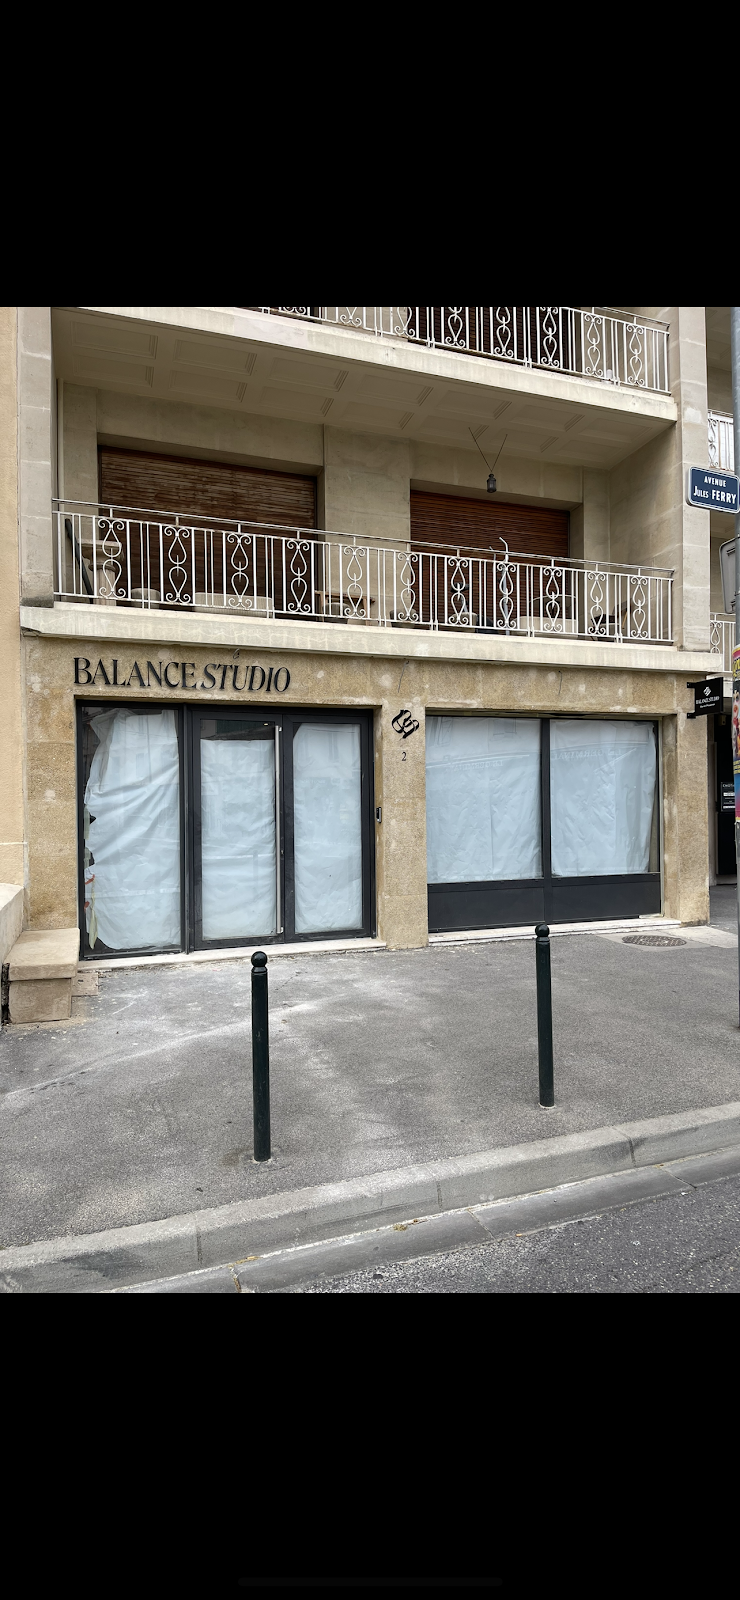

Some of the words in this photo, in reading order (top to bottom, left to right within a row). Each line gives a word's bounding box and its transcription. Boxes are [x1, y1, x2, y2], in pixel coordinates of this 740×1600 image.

[704, 476, 727, 487] AVENUE
[711, 489, 736, 504] FERRY
[73, 657, 197, 689] BALANCE
[200, 663, 291, 692] STUDIO
[401, 751, 407, 762] 2
